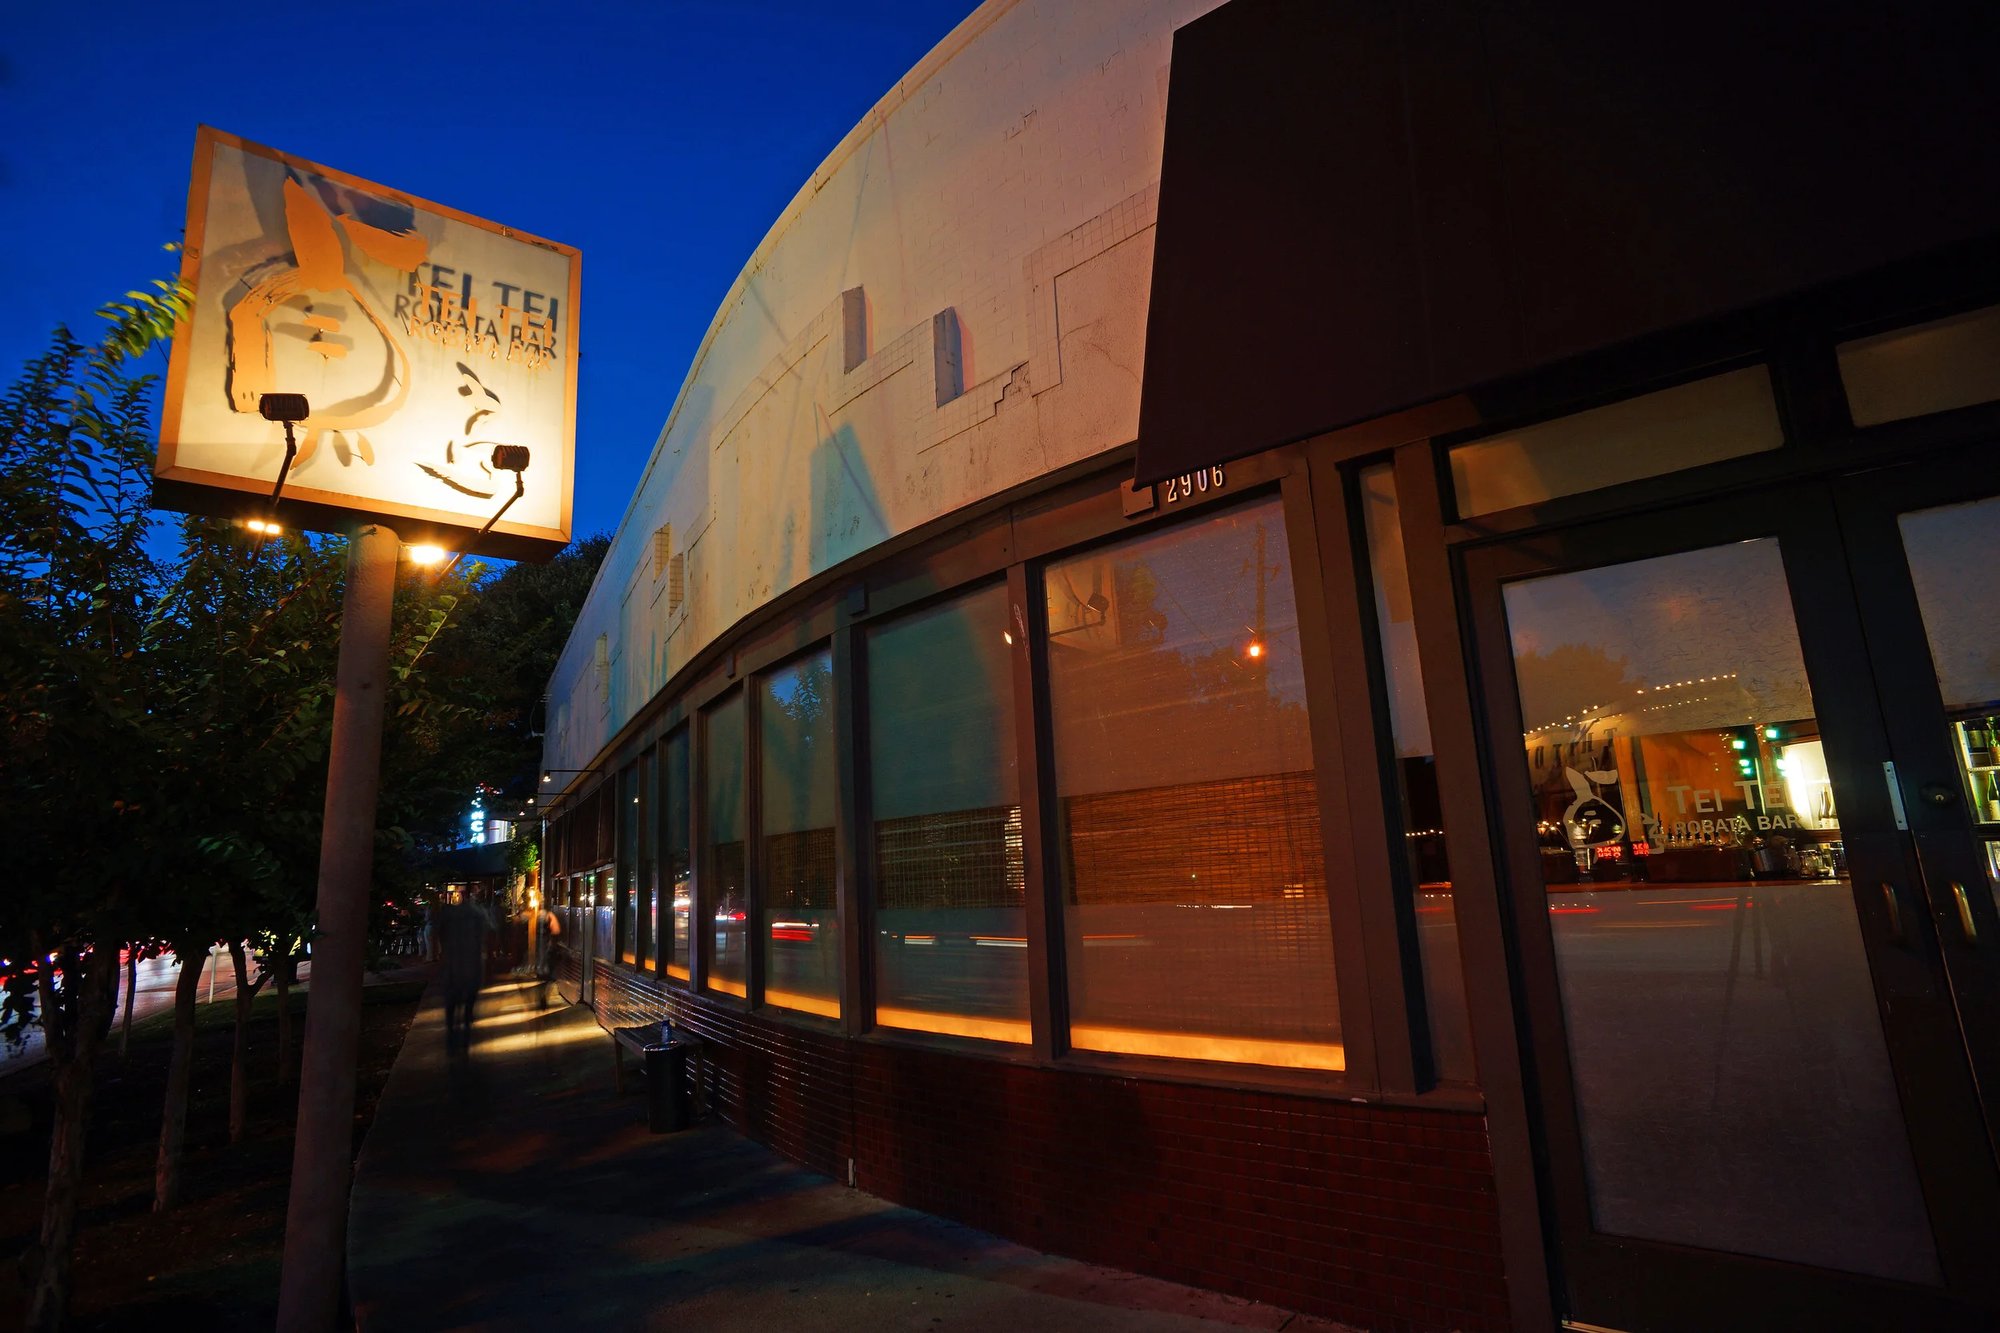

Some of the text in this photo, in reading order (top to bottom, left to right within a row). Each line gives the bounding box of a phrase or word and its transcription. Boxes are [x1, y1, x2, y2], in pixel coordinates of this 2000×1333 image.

[408, 262, 558, 348] TEI TEI
[395, 294, 557, 370] ROBATA BAR
[1166, 464, 1223, 502] 2906
[1667, 785, 1724, 814] TEI
[1675, 814, 1801, 835] ROBATA BAR
